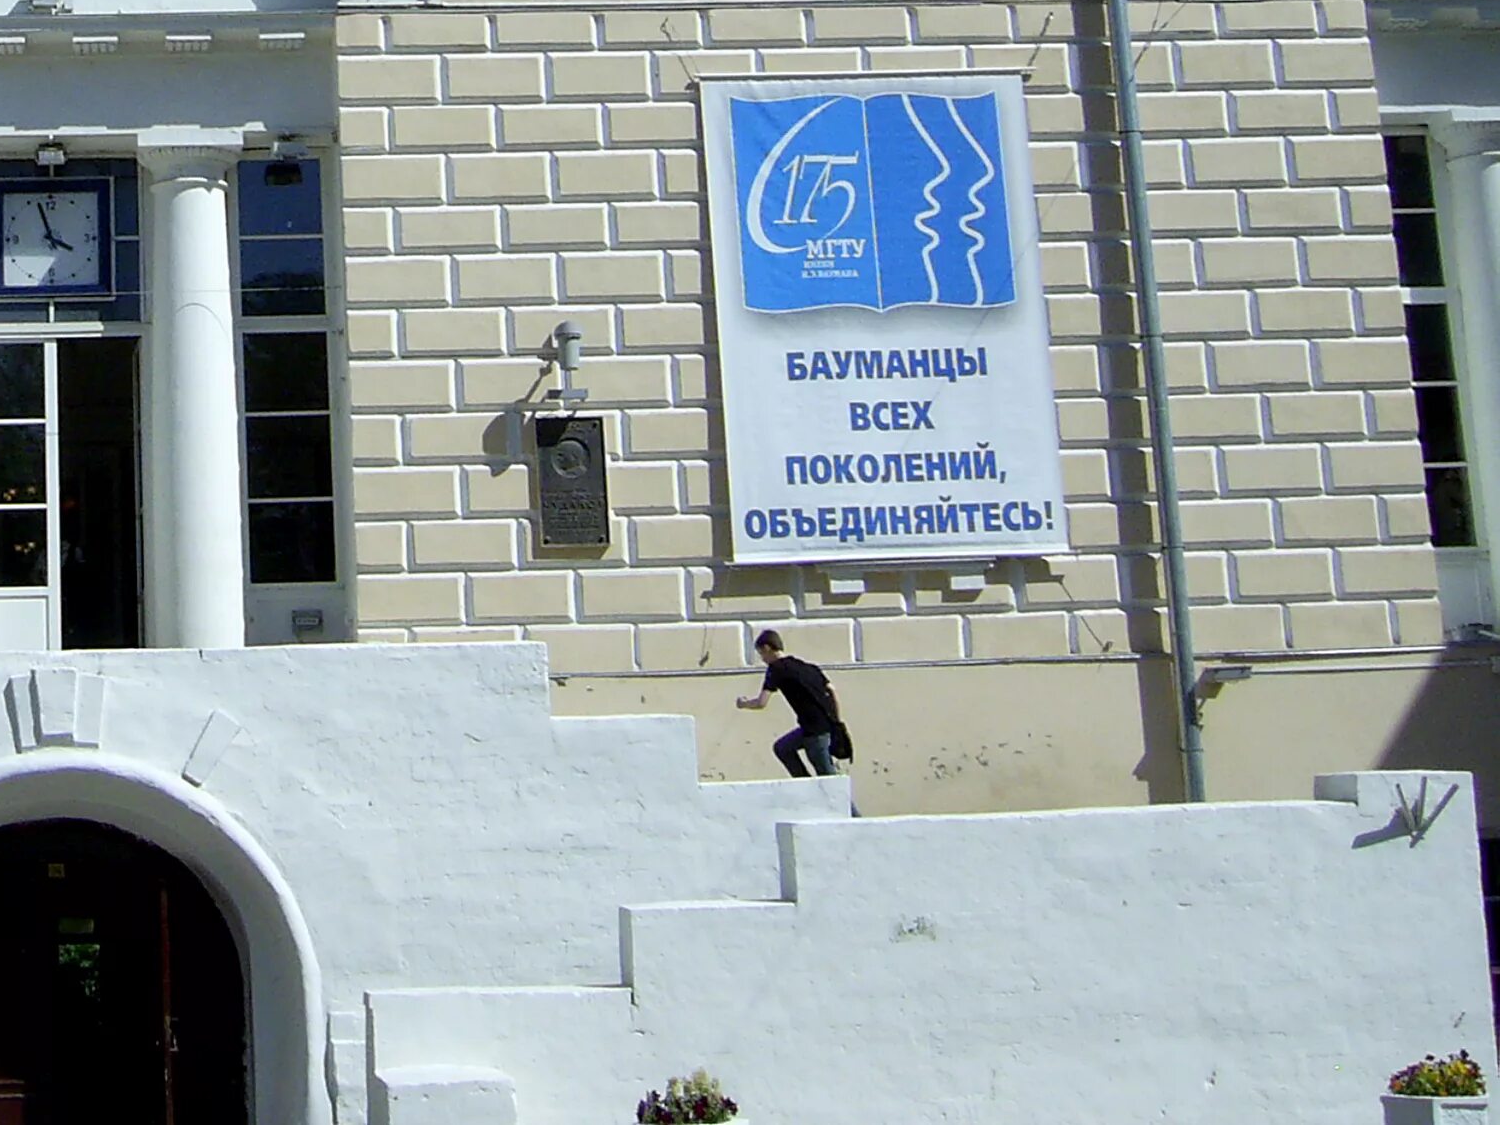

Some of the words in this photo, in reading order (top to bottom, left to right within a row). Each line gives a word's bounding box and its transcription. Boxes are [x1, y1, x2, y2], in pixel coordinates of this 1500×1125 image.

[45, 200, 56, 211] 12
[774, 151, 859, 239] 175
[84, 233, 90, 243] 3
[806, 239, 866, 259] МГТУ
[786, 347, 988, 382] БАУМАНЦЫ
[849, 401, 935, 431] ВСЕХ
[785, 442, 1006, 485] ПОКОЛЕНИЙ,
[744, 495, 1053, 542] ОБЪЕДИНЯЙТЕСЬ!
